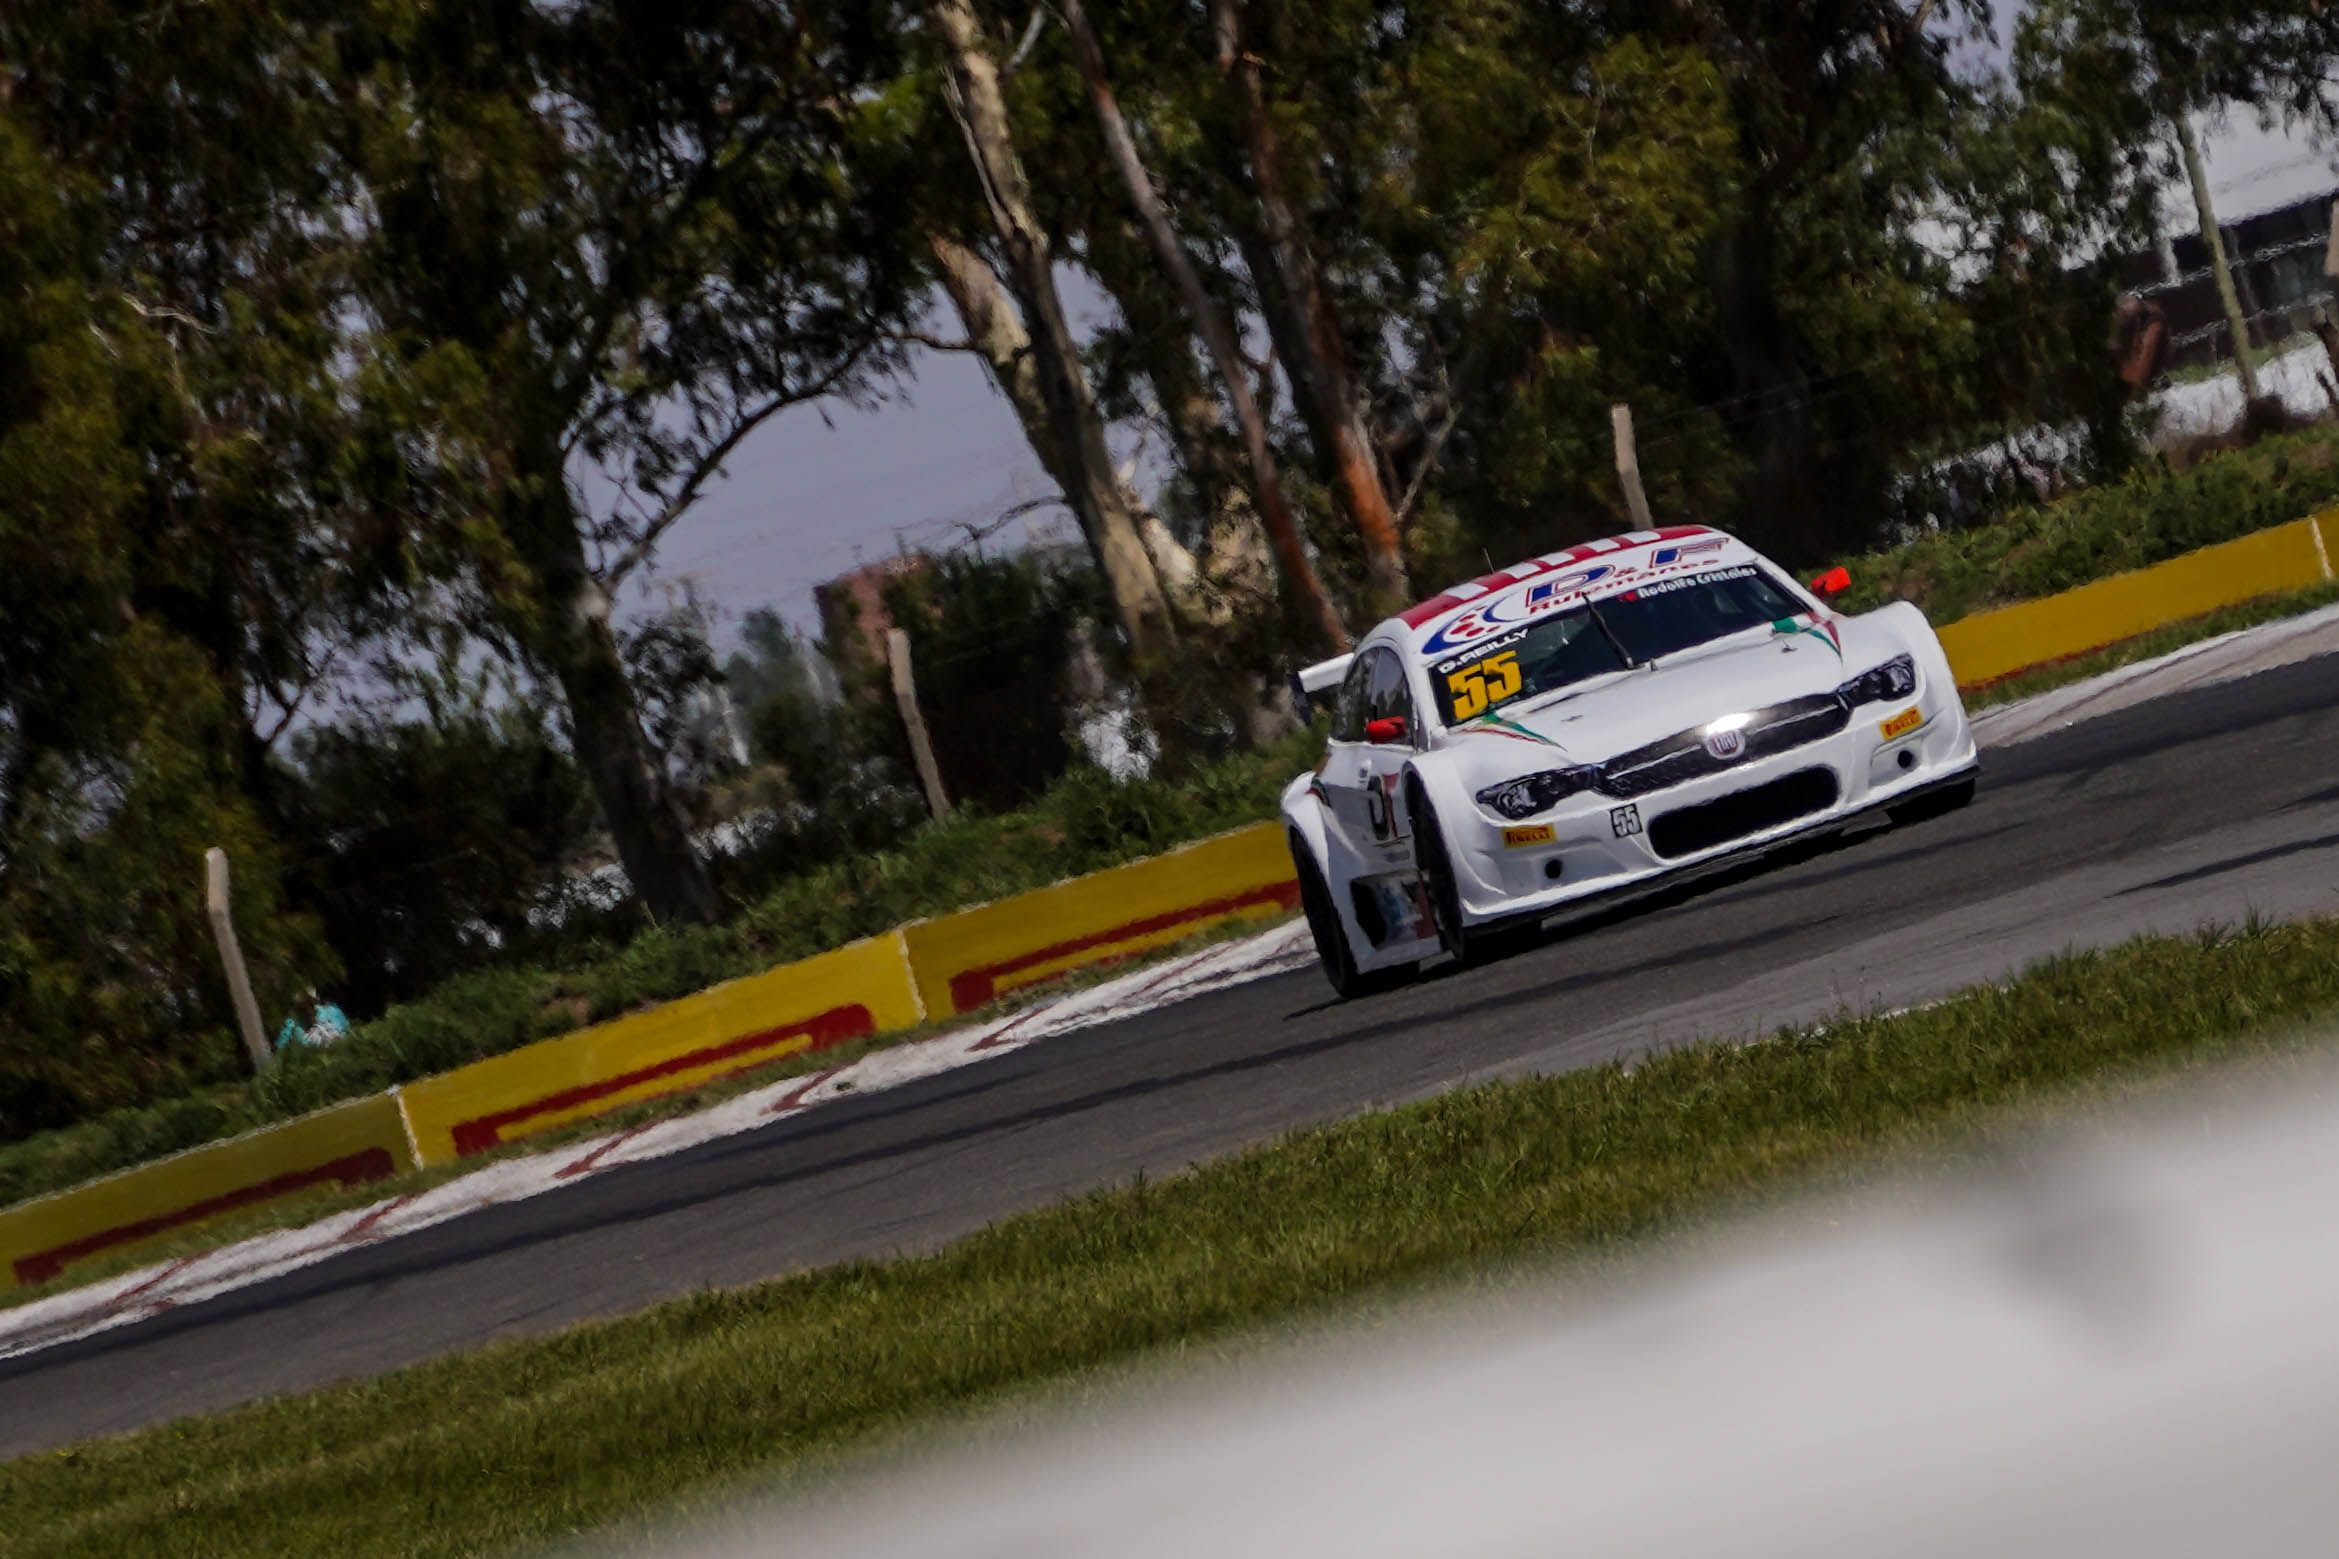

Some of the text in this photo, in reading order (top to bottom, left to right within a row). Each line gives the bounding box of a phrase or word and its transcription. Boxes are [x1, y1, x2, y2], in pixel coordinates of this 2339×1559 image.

[1447, 650, 1522, 719] 55
[1505, 826, 1551, 845] PIRELLI
[1611, 805, 1641, 837] 55
